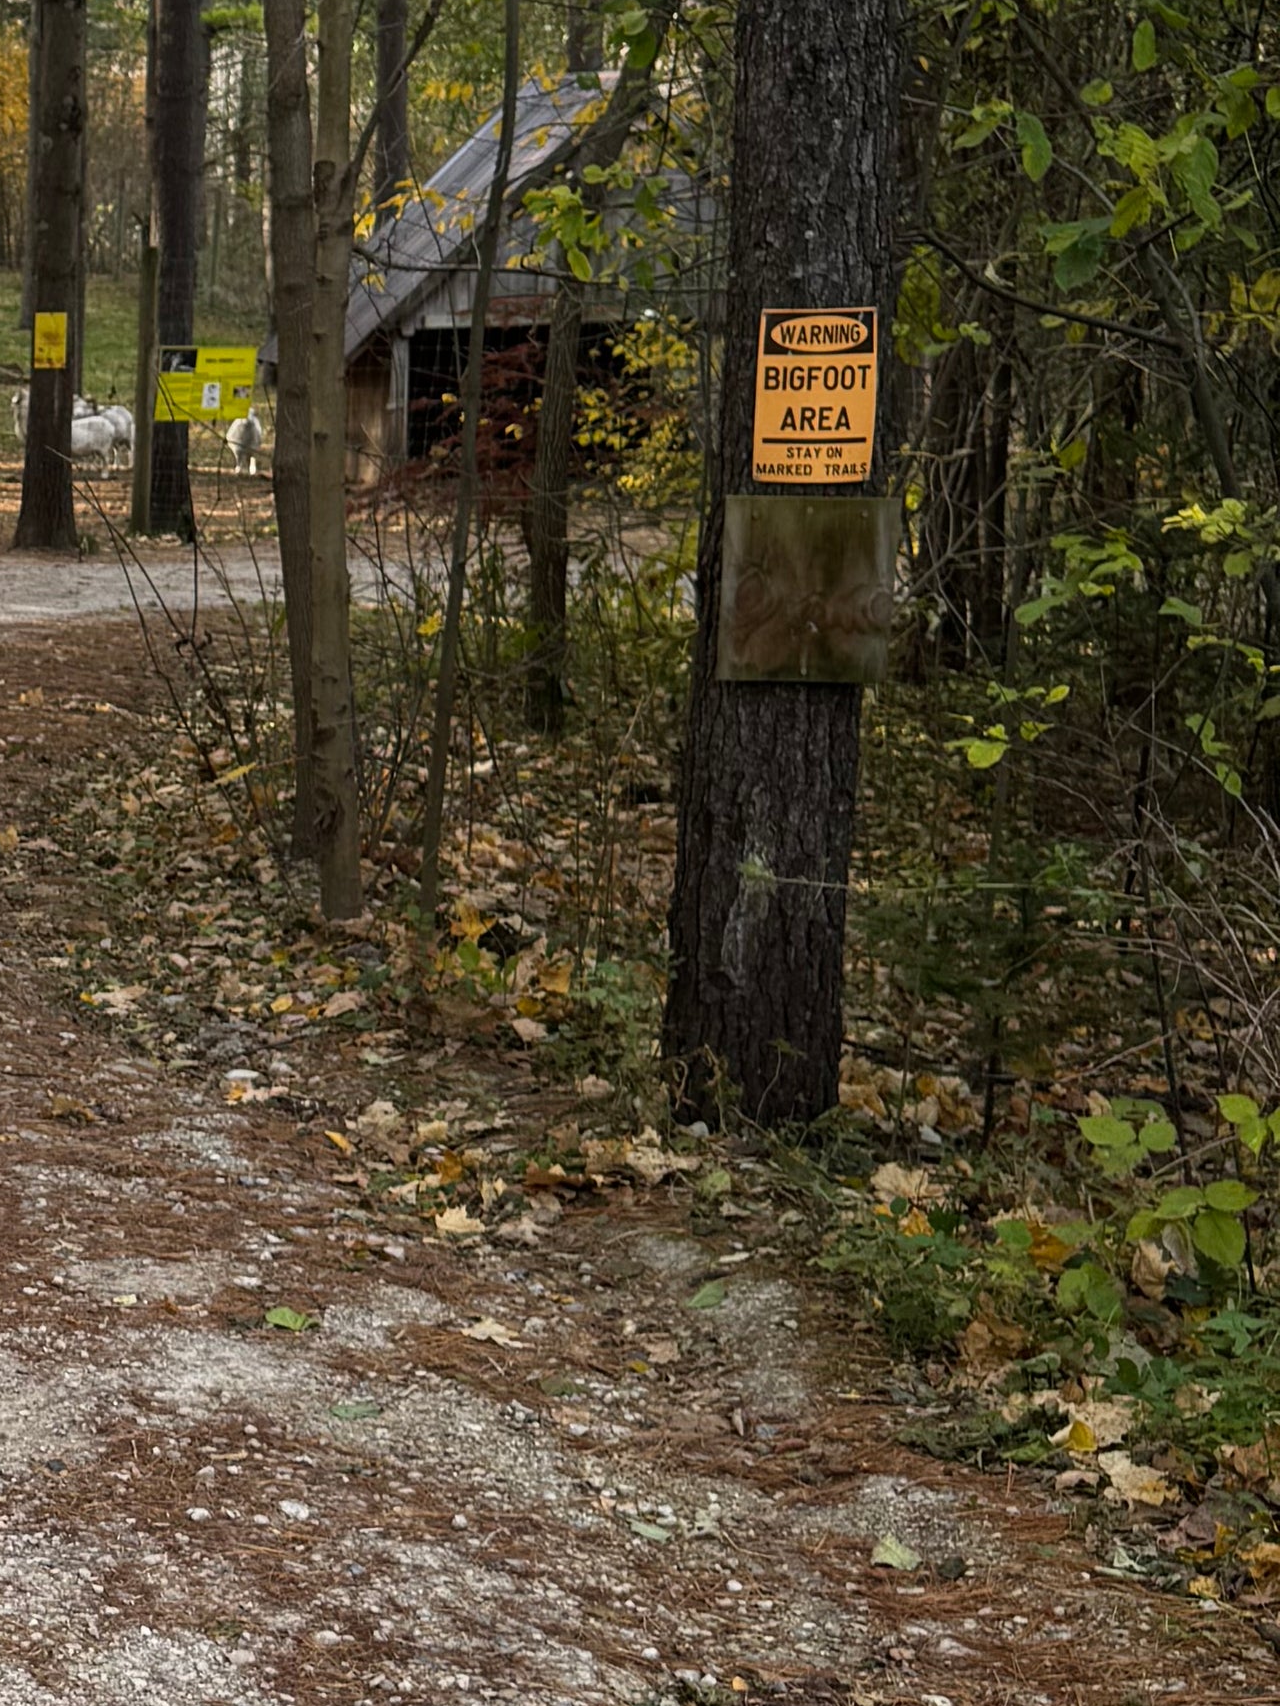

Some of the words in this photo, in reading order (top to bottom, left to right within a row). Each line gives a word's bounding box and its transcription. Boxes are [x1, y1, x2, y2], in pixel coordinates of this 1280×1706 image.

[779, 323, 861, 345] WARNING
[764, 365, 871, 391] BIGFOOT
[780, 406, 851, 431] AREA
[786, 446, 822, 459] STAY
[826, 446, 843, 459] ON
[756, 463, 813, 476] MARKED
[824, 462, 867, 476] TRAILS
